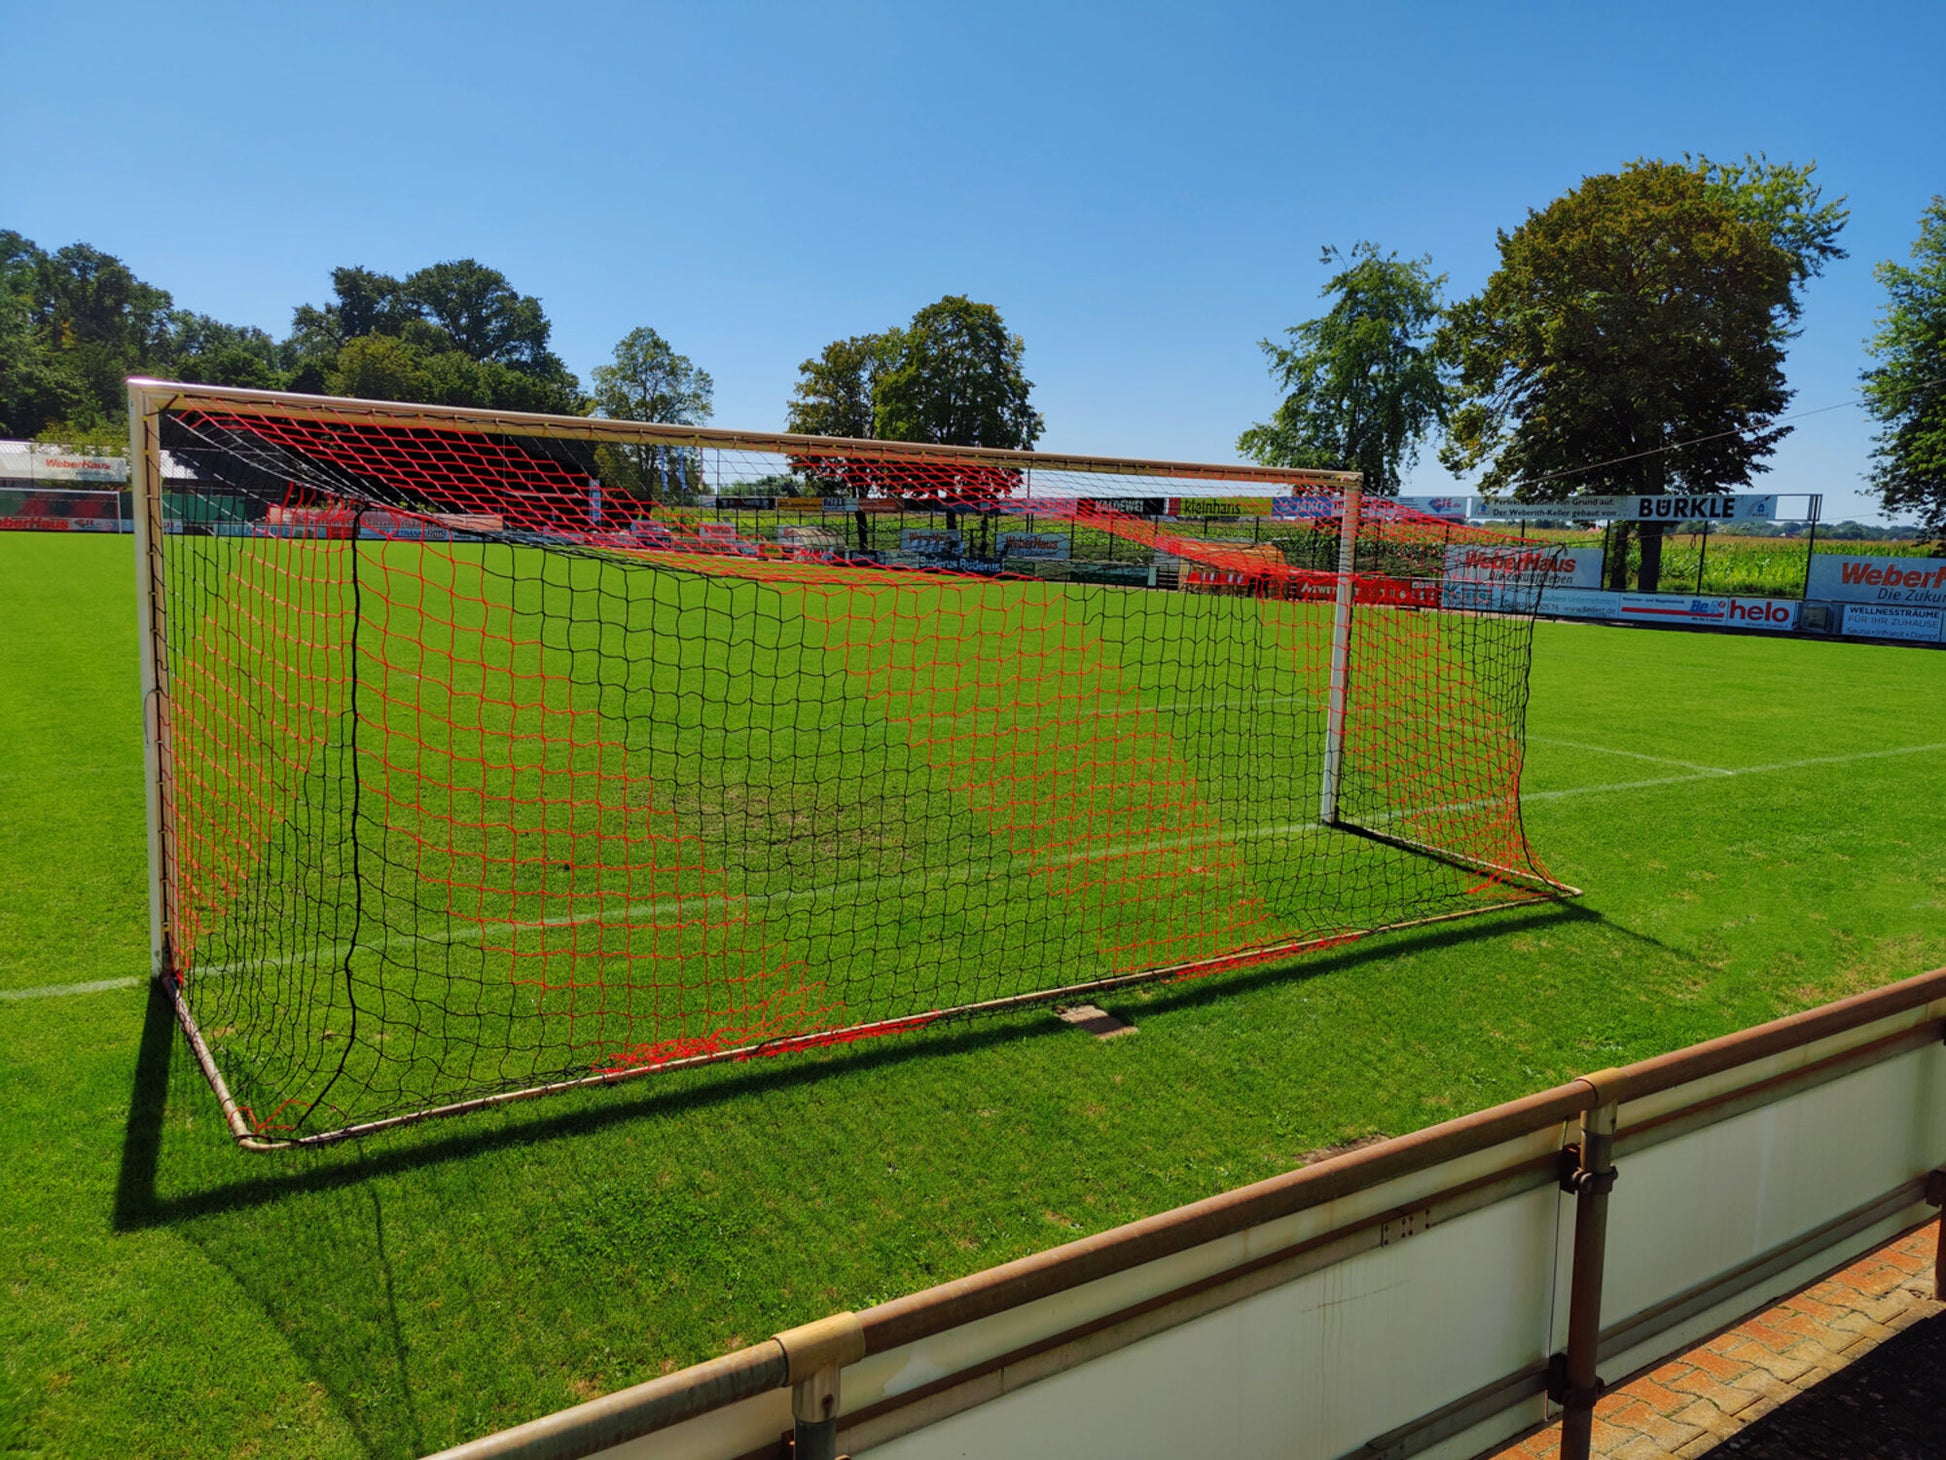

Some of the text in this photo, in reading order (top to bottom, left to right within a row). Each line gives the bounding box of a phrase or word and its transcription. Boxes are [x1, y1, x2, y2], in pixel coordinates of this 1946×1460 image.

[1493, 508, 1507, 516] Der
[1572, 508, 1599, 518] gebaut
[1639, 497, 1735, 518] BÜRKLE
[1877, 587, 1902, 600] Die
[1729, 599, 1789, 622] helo
[1850, 606, 1939, 619] WELLNESSTRÄUME
[1848, 615, 1939, 629] FÜR IHR ZUHAUSE
